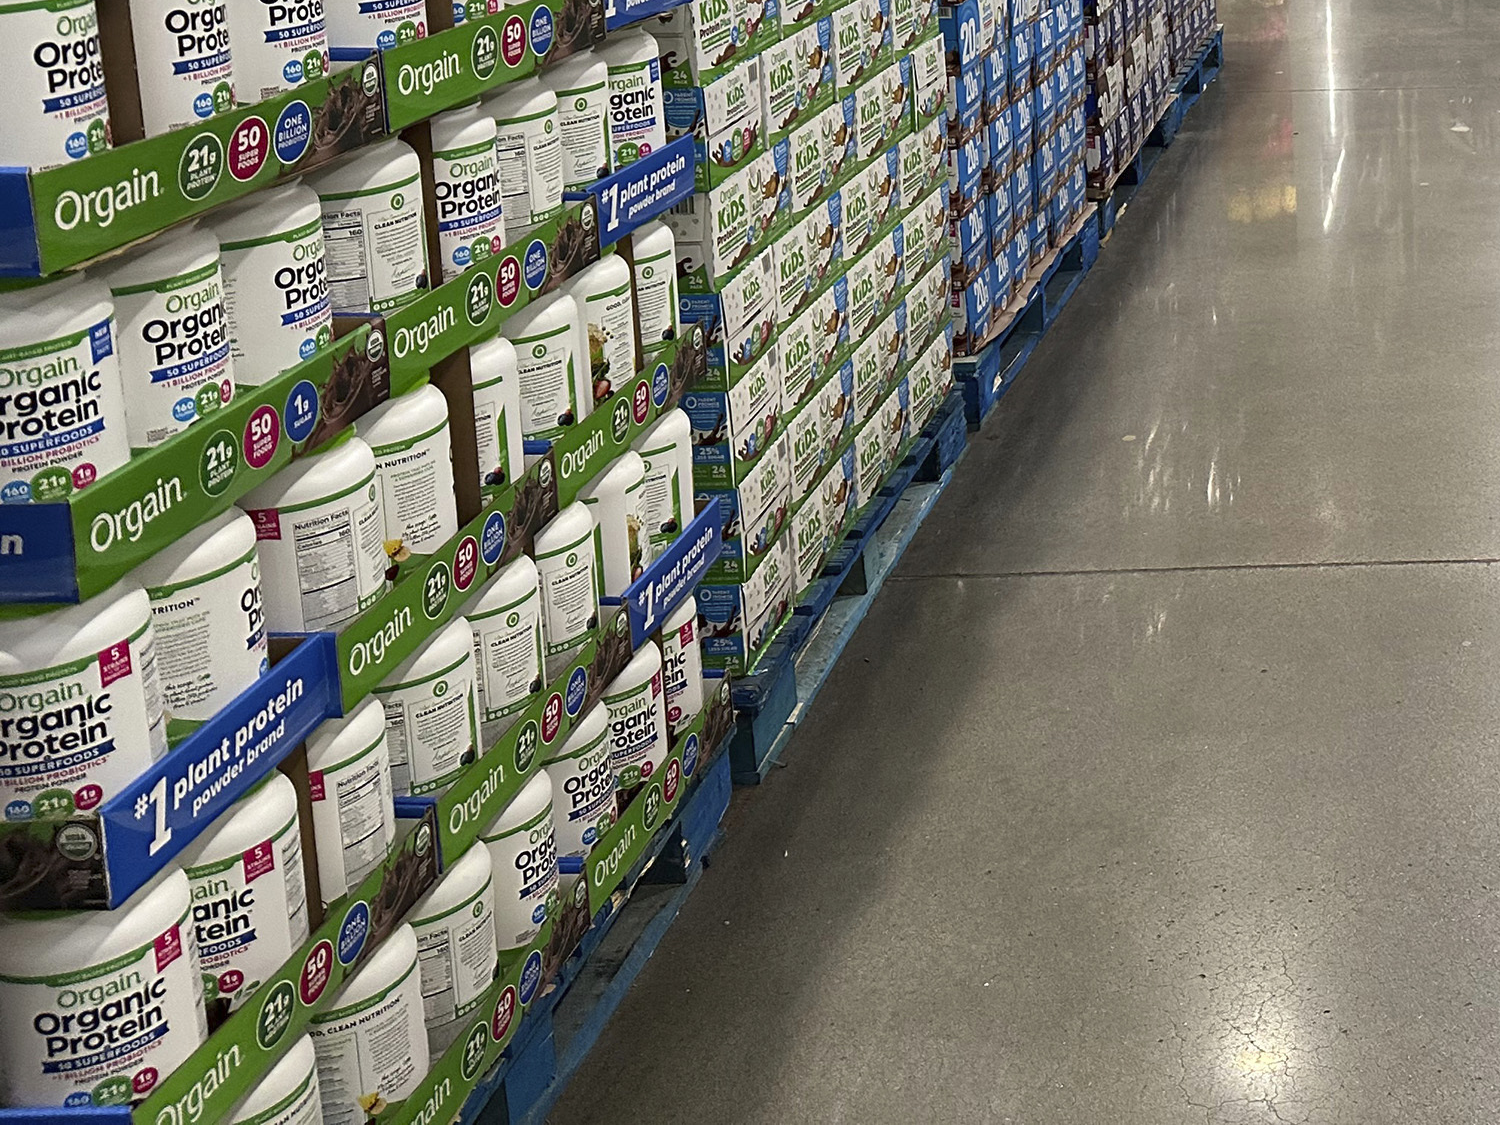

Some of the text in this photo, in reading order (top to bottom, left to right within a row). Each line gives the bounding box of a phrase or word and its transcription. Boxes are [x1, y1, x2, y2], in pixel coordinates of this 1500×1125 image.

[398, 51, 461, 95] Orgain
[673, 71, 687, 80] 24
[55, 169, 159, 230] Orgain
[601, 154, 685, 232] #1 plant protein
[628, 180, 675, 219] powder brand
[394, 307, 456, 358] Orgain
[294, 412, 312, 428] SUGAR
[295, 394, 309, 415] 1g
[384, 449, 426, 468] NUTRITION
[91, 477, 183, 552] Orgain
[294, 509, 349, 531] Nutrition Facts
[349, 606, 412, 676] Orgain
[134, 677, 303, 857] #1 plant protein
[192, 720, 286, 817] powder brand
[34, 977, 166, 1035] Organic
[57, 969, 141, 1009] Orgain
[46, 1005, 162, 1058] Protein
